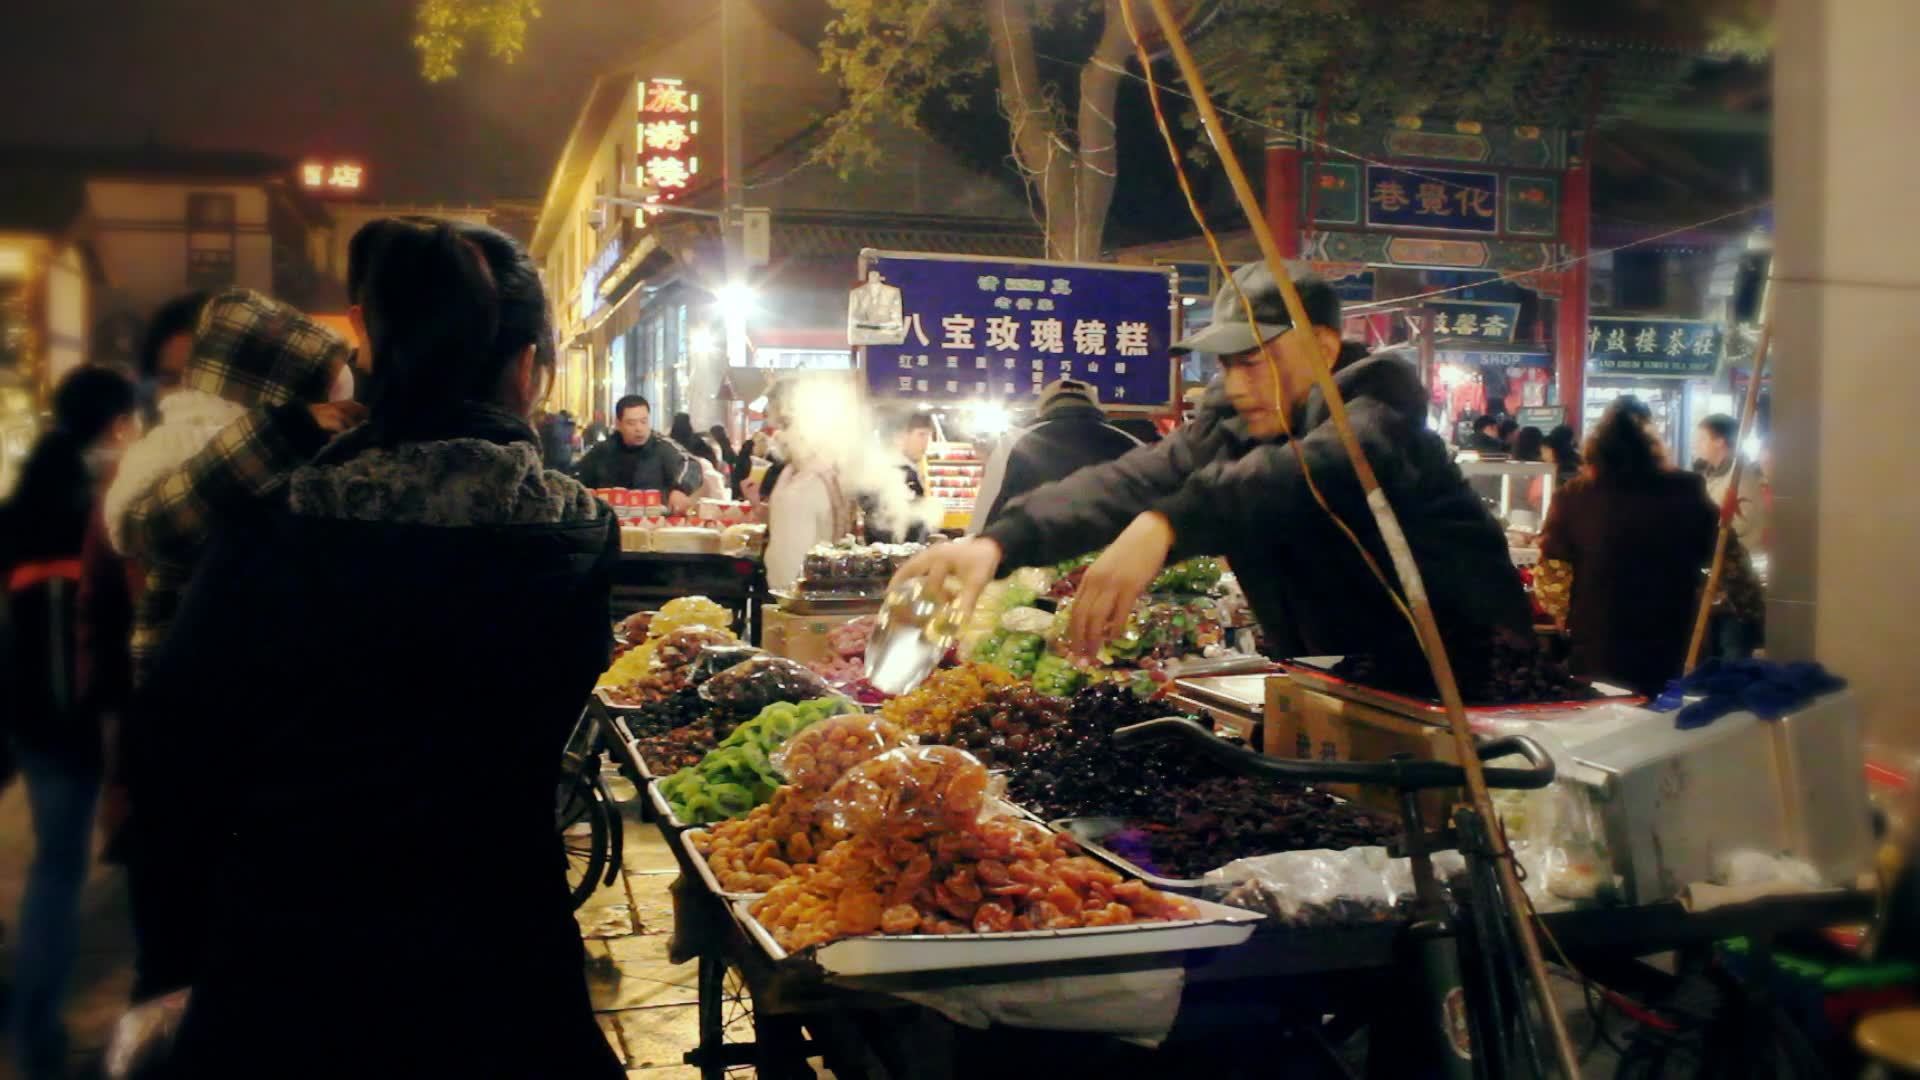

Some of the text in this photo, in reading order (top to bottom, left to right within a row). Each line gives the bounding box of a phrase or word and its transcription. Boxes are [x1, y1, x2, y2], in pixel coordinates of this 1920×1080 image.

[902, 313, 1149, 356] 八宝玫瑰镜糕
[1480, 353, 1521, 366] SHOP
